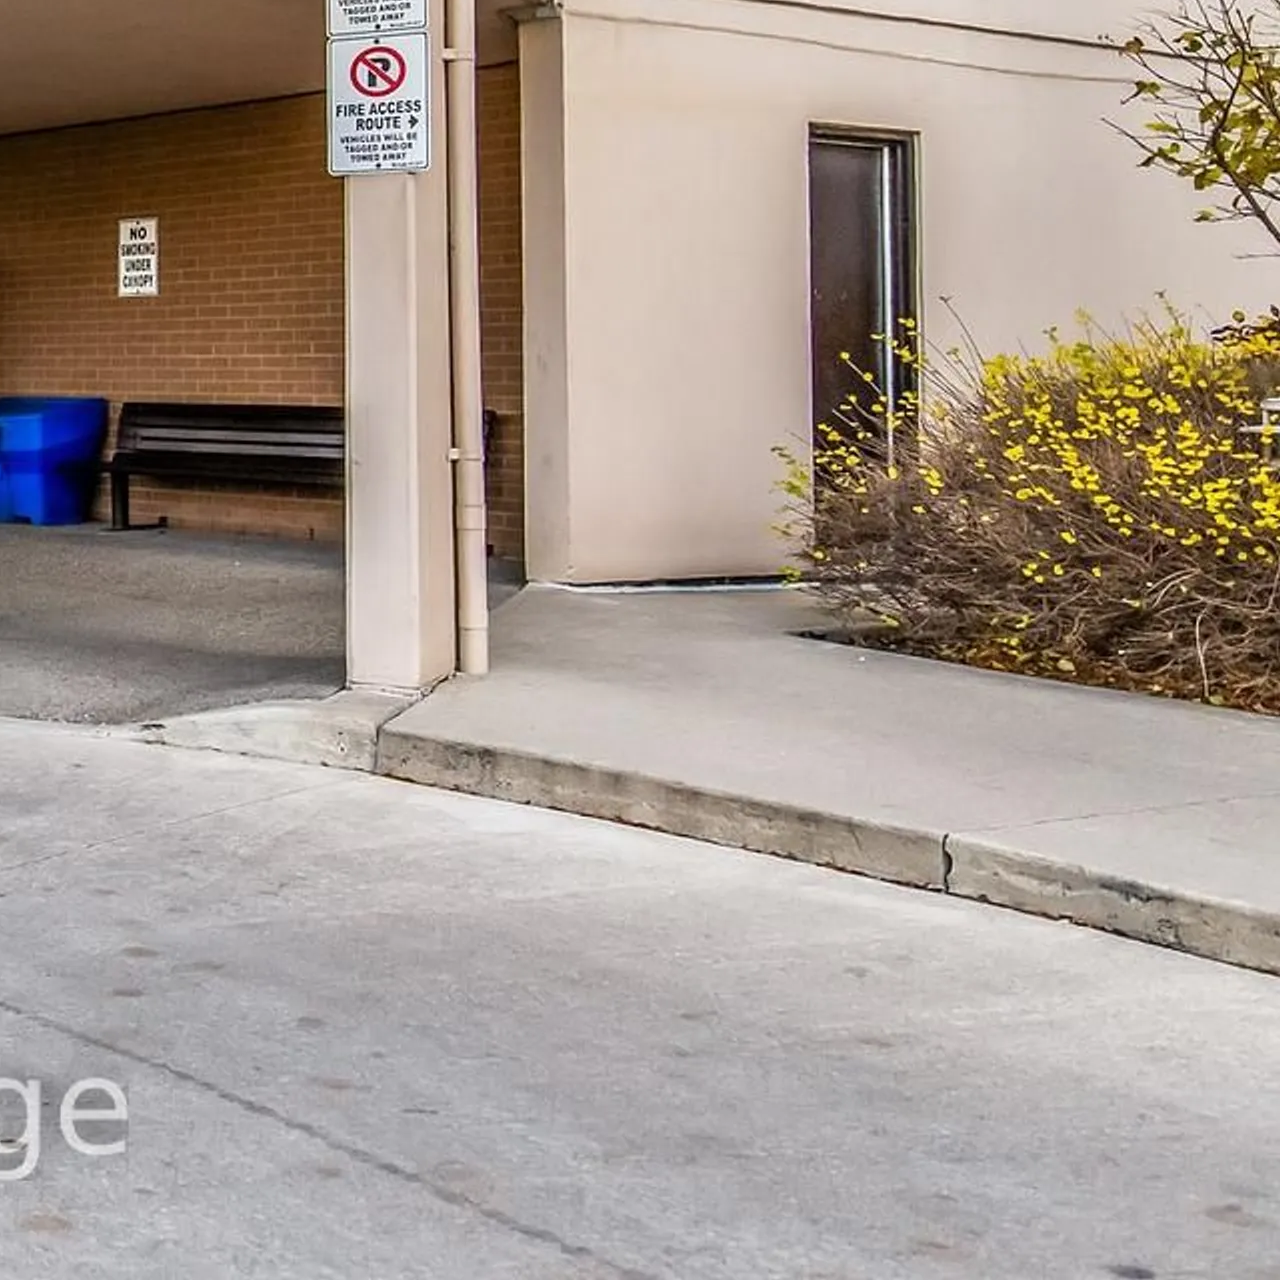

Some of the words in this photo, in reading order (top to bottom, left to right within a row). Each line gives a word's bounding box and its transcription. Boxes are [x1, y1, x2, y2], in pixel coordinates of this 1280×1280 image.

[342, 6, 377, 16] TAGGED
[349, 15, 378, 24] TOWED
[381, 12, 405, 21] AWAY
[336, 104, 365, 117] FIRE
[369, 100, 421, 115] ACCESS
[356, 116, 401, 131] ROUTE
[340, 135, 381, 144] VEHICLES
[383, 133, 404, 141] WILL
[406, 132, 417, 140] BE
[344, 144, 378, 153] TAGGED
[350, 154, 379, 163] TOWED
[382, 153, 406, 161] AWAY
[130, 227, 147, 240] NO
[121, 242, 155, 256] SMOKING
[124, 258, 151, 272] UNDER
[122, 274, 153, 288] CANOPY
